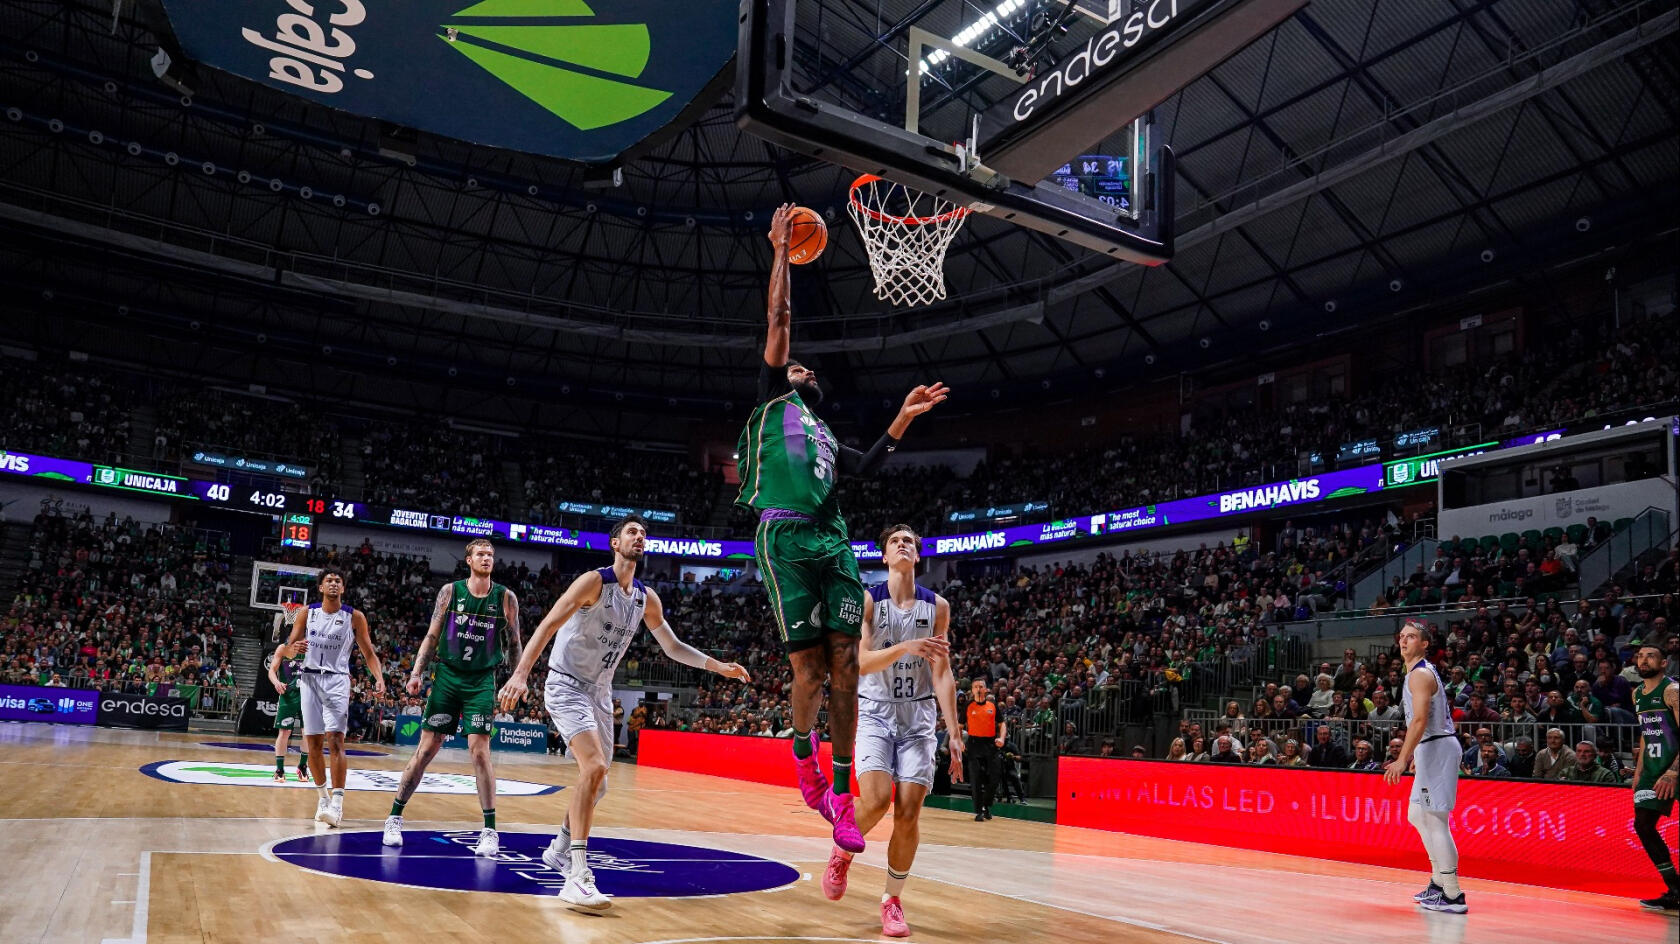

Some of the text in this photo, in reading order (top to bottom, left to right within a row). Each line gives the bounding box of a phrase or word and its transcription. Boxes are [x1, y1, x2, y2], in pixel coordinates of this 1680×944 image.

[1013, 0, 1177, 121] endesa
[124, 474, 177, 493] UNICAJA
[206, 484, 230, 501] 40
[250, 490, 286, 509] 4:02
[306, 498, 325, 514] 18
[332, 501, 354, 519] 34
[290, 514, 311, 524] 4:02
[390, 516, 428, 528] BADALONA
[392, 509, 428, 521] JOVENTUT
[1122, 509, 1140, 520] most
[1133, 515, 1156, 527] choice
[289, 525, 310, 541] 18
[544, 529, 562, 537] most
[555, 536, 578, 546] choice
[468, 618, 494, 630] Unicaja
[457, 630, 485, 642] málaga
[462, 646, 474, 662] 2
[893, 676, 914, 698] 23
[101, 699, 186, 718] endesa
[500, 728, 544, 739] Fundación
[500, 736, 532, 746] Unicaja
[1646, 742, 1662, 758] 27
[1222, 786, 1274, 814] LED
[1310, 793, 1567, 843] ILUMICIÓN
